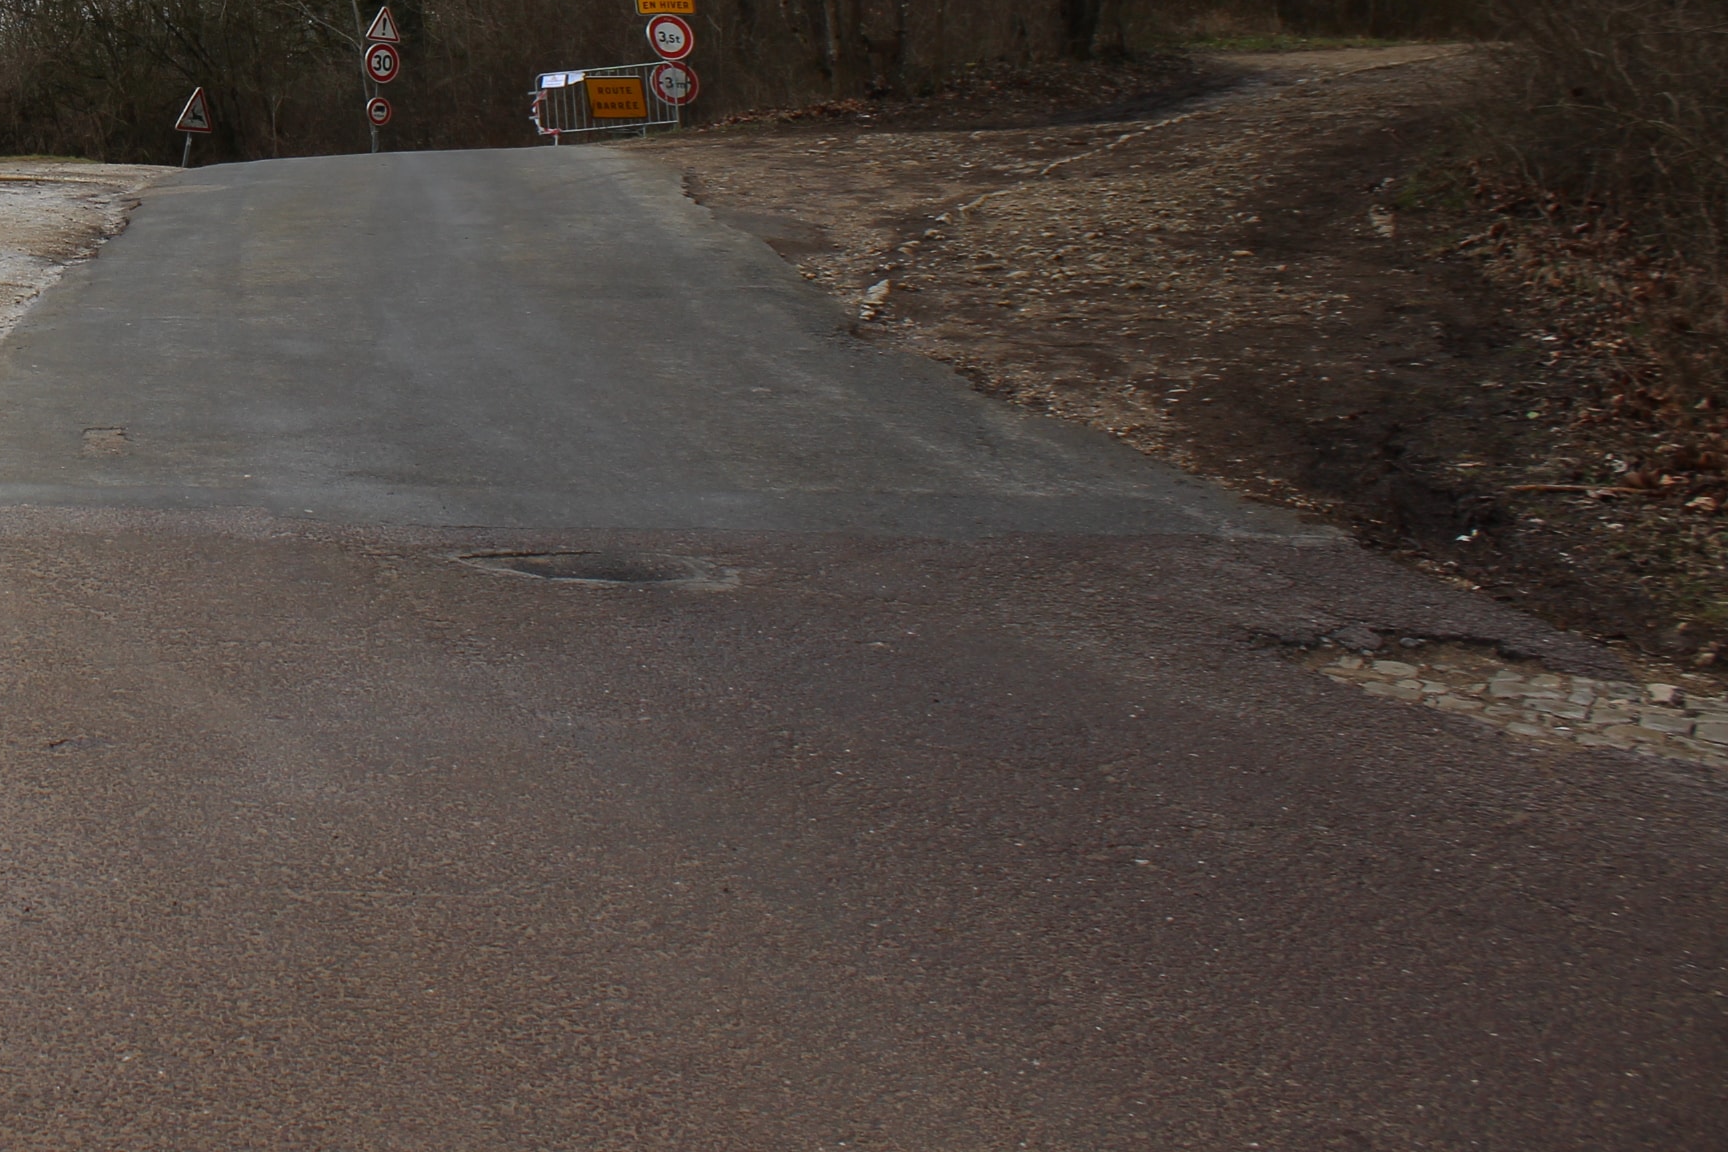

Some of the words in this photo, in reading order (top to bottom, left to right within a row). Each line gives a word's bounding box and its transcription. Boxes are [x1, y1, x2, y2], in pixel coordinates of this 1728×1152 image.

[643, 1, 656, 10] EN
[659, 1, 689, 9] HIVER
[373, 54, 392, 71] 30
[665, 76, 674, 88] 3
[597, 86, 633, 94] ROUTE
[597, 100, 640, 110] BARRÉE
